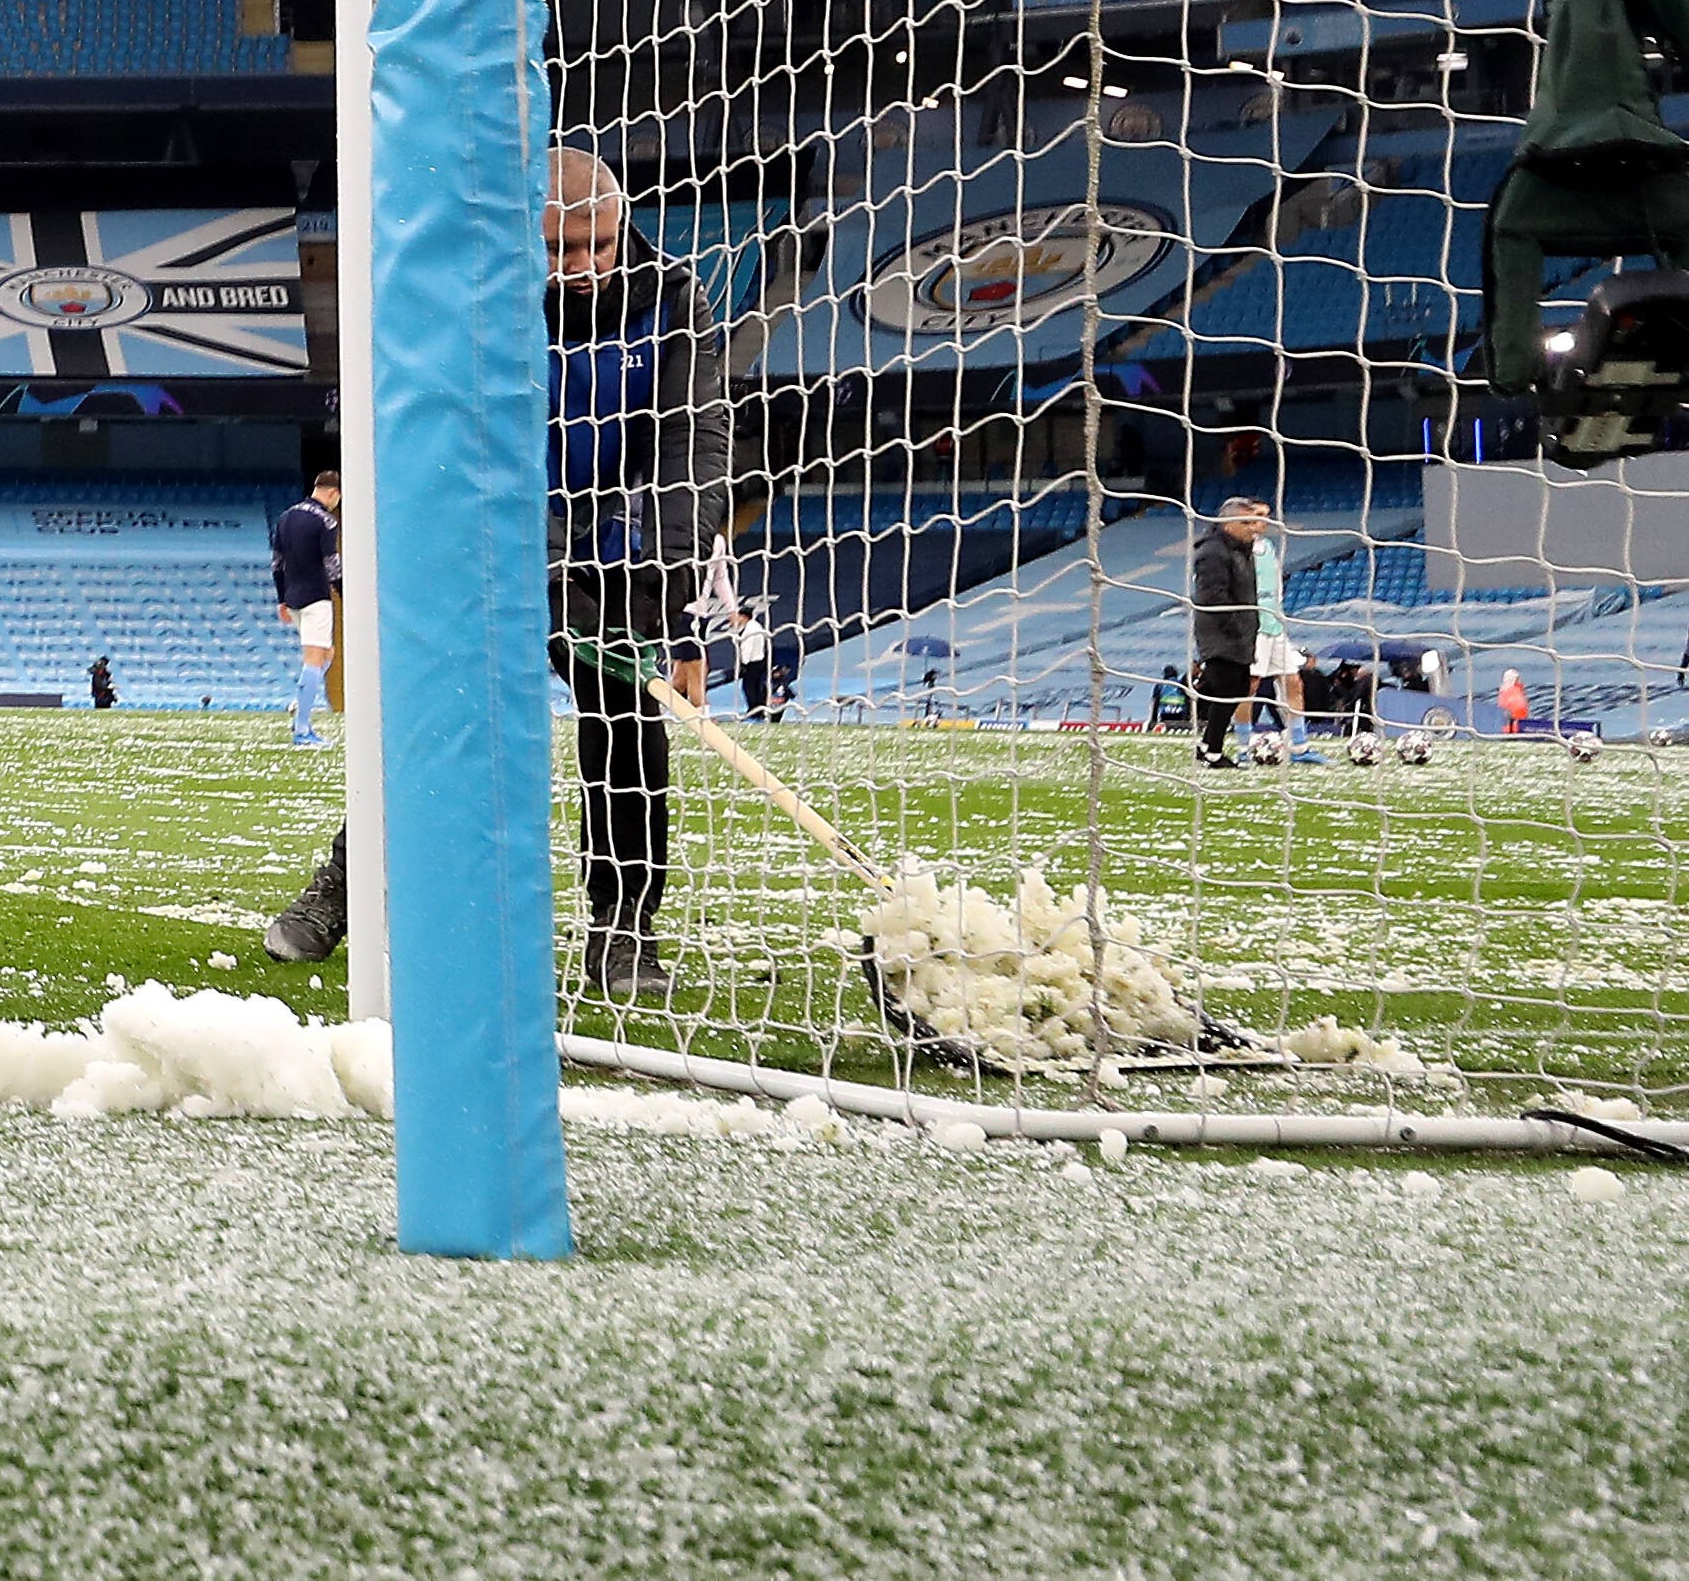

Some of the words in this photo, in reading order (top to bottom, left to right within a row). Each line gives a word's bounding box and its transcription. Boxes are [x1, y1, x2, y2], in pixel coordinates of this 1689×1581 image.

[162, 286, 215, 308] AND
[220, 286, 290, 308] BRED
[53, 318, 98, 327] CITY
